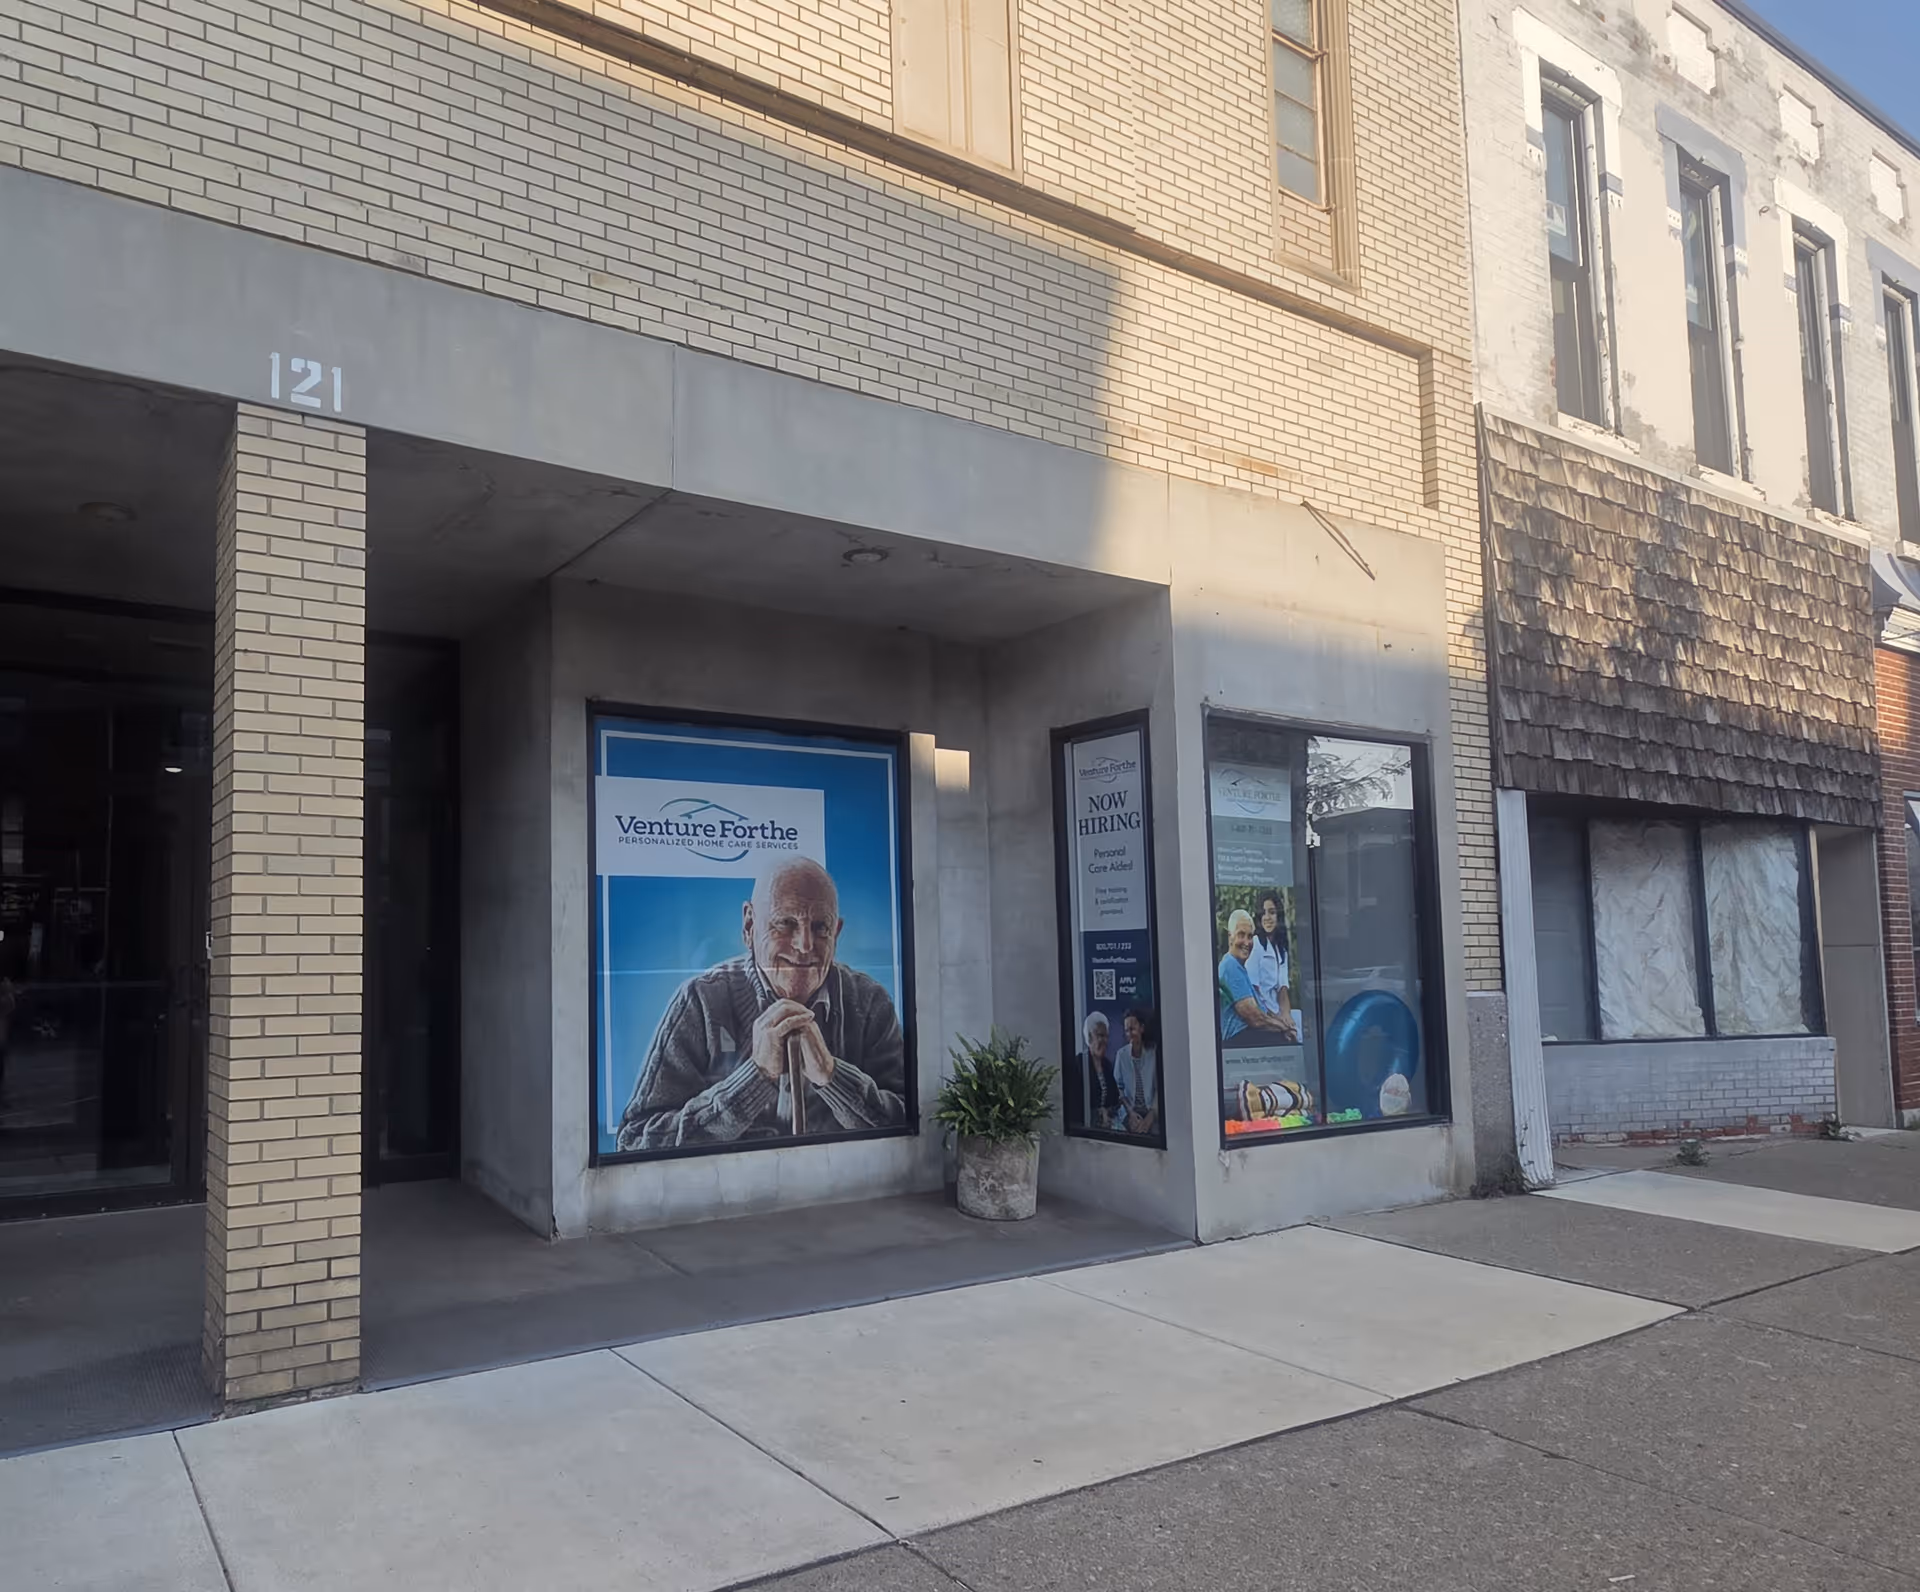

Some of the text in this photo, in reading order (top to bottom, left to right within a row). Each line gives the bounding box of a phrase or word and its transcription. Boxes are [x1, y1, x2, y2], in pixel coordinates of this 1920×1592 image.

[269, 352, 342, 412] 121
[1088, 790, 1128, 813] NOW
[1078, 811, 1141, 836] HIRING
[618, 836, 800, 850] PERSONALIZED HOME CARE SERVICES
[1094, 845, 1126, 858] Personal
[1088, 863, 1108, 874] Care
[1119, 976, 1136, 984] APPLY
